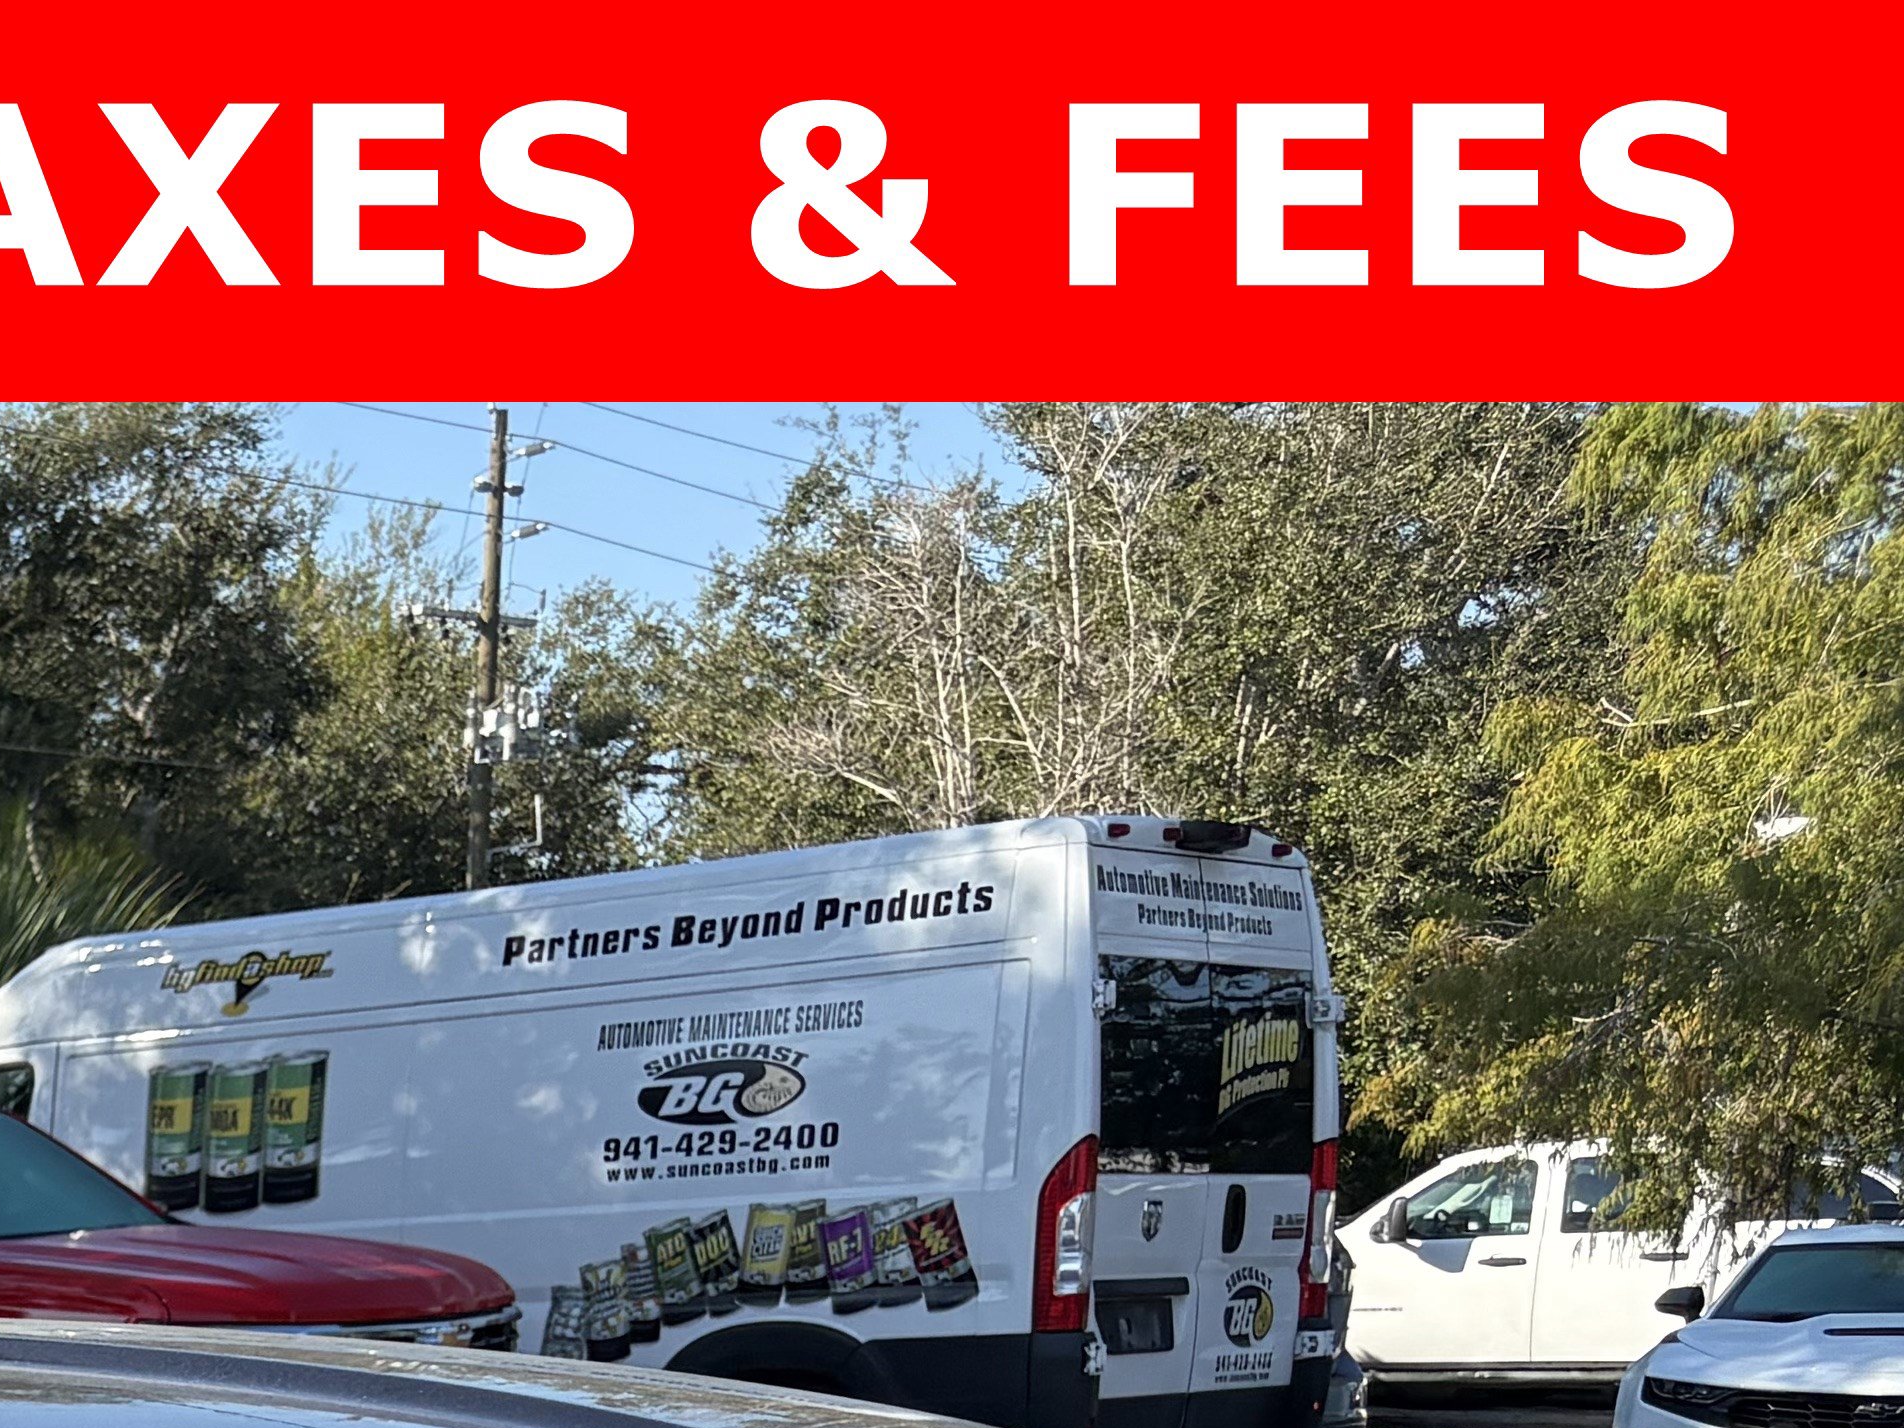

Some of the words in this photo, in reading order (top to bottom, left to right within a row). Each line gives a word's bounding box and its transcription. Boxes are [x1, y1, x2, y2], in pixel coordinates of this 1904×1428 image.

[1097, 865, 1169, 898] Automotive
[1170, 872, 1248, 907] Maintenance
[1249, 881, 1303, 912] Solutions
[502, 923, 661, 966] Partners
[671, 901, 805, 948] Beyond
[814, 881, 995, 931] Products
[598, 1017, 684, 1051] AUTOMOTIVE
[689, 1007, 791, 1043] MAINTENANCE
[795, 1000, 864, 1033] SERVICES
[1220, 1011, 1300, 1086] Lifetime
[643, 1042, 809, 1077] SUNCOAST
[655, 1070, 746, 1118] BG
[603, 1122, 840, 1163] 941-429-2400
[607, 1154, 830, 1182] www.suncoastbg.com
